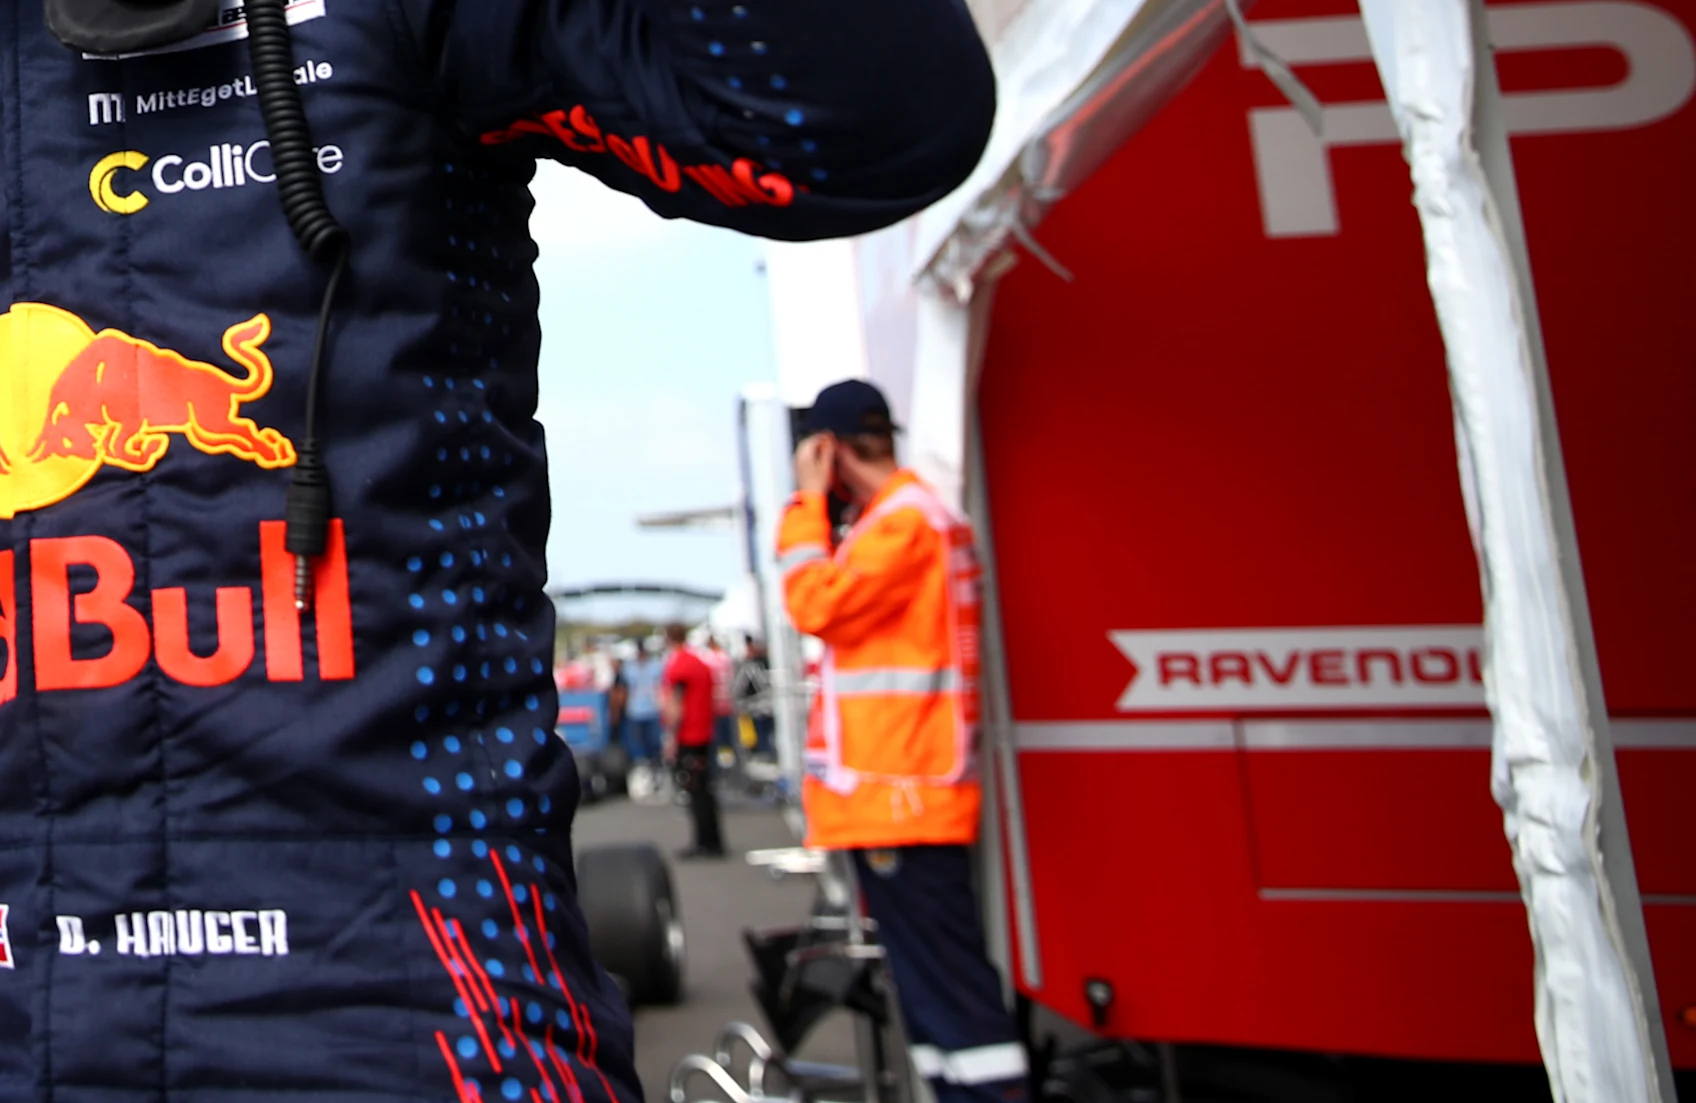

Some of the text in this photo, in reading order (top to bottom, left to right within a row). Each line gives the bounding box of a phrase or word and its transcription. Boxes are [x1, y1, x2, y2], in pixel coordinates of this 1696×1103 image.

[29, 518, 355, 691] Bull
[56, 909, 289, 956] D. HAUGER
